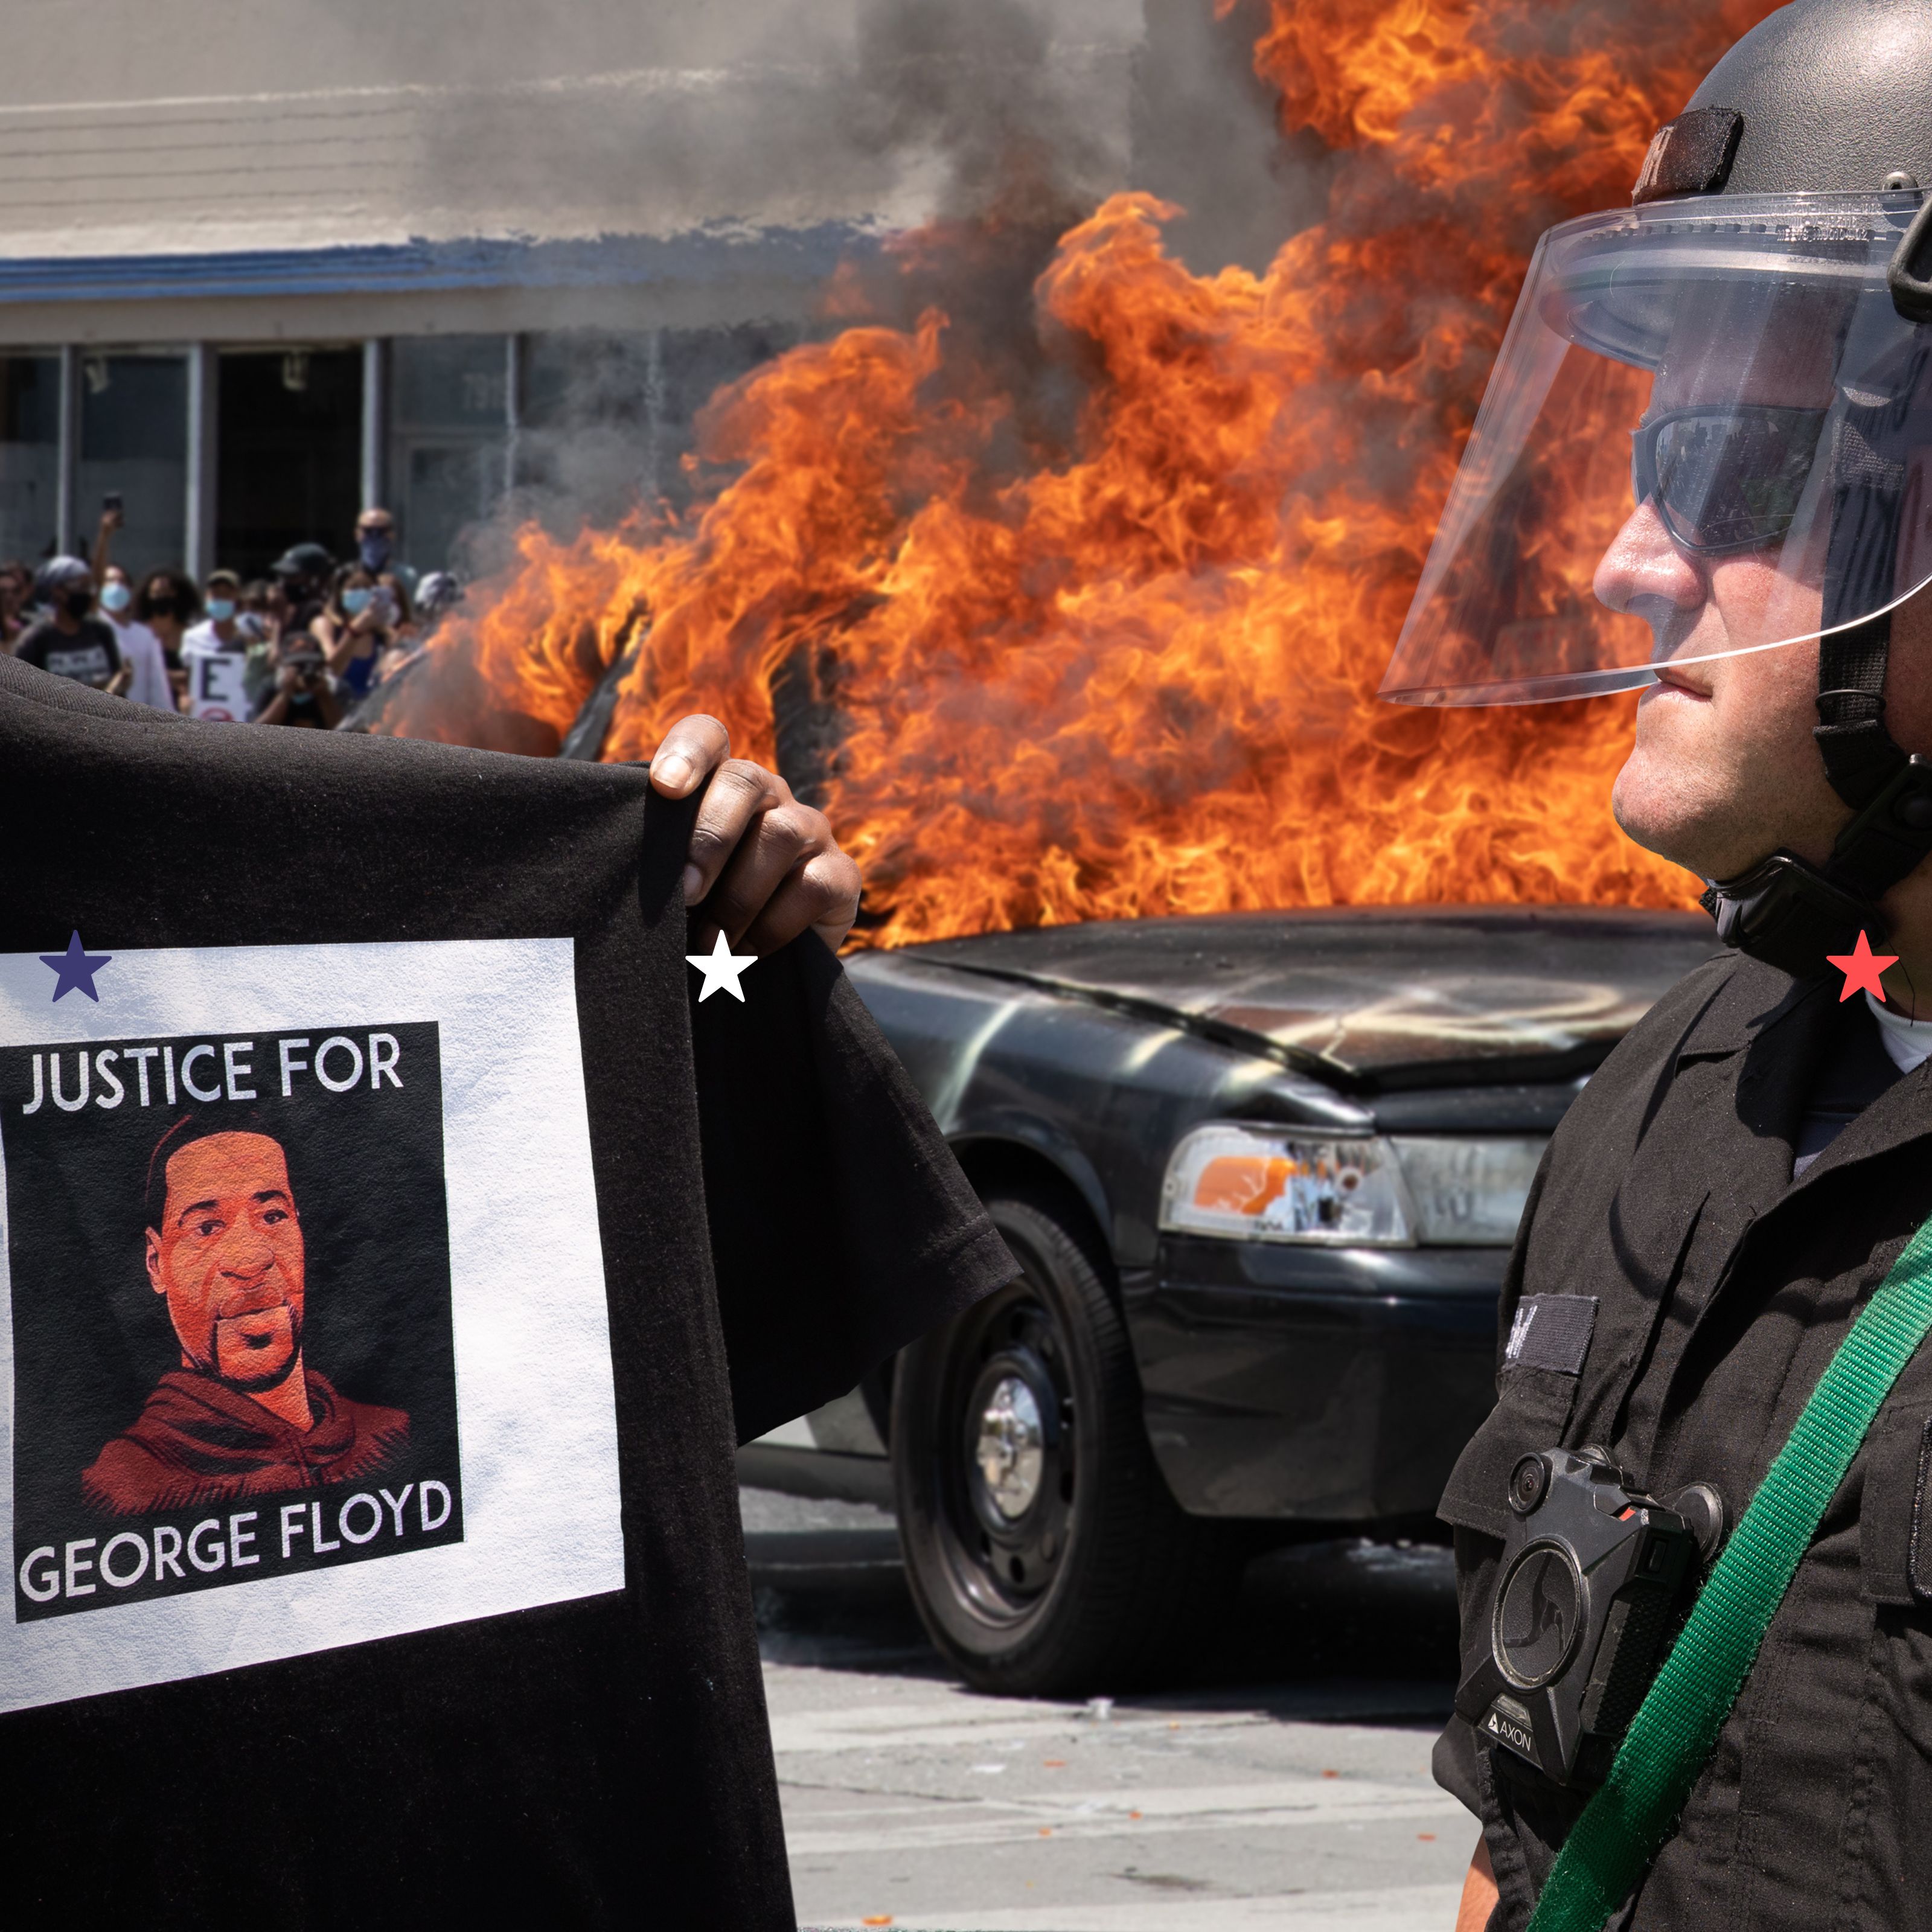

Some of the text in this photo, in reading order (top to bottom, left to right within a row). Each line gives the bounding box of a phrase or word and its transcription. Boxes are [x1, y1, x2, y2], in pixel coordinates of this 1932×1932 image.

[201, 657, 231, 701] E
[22, 1032, 405, 1115] JUSTICE FOR
[19, 1480, 452, 1602] GEORGE FLOYD
[1500, 1721, 1532, 1751] AXON
